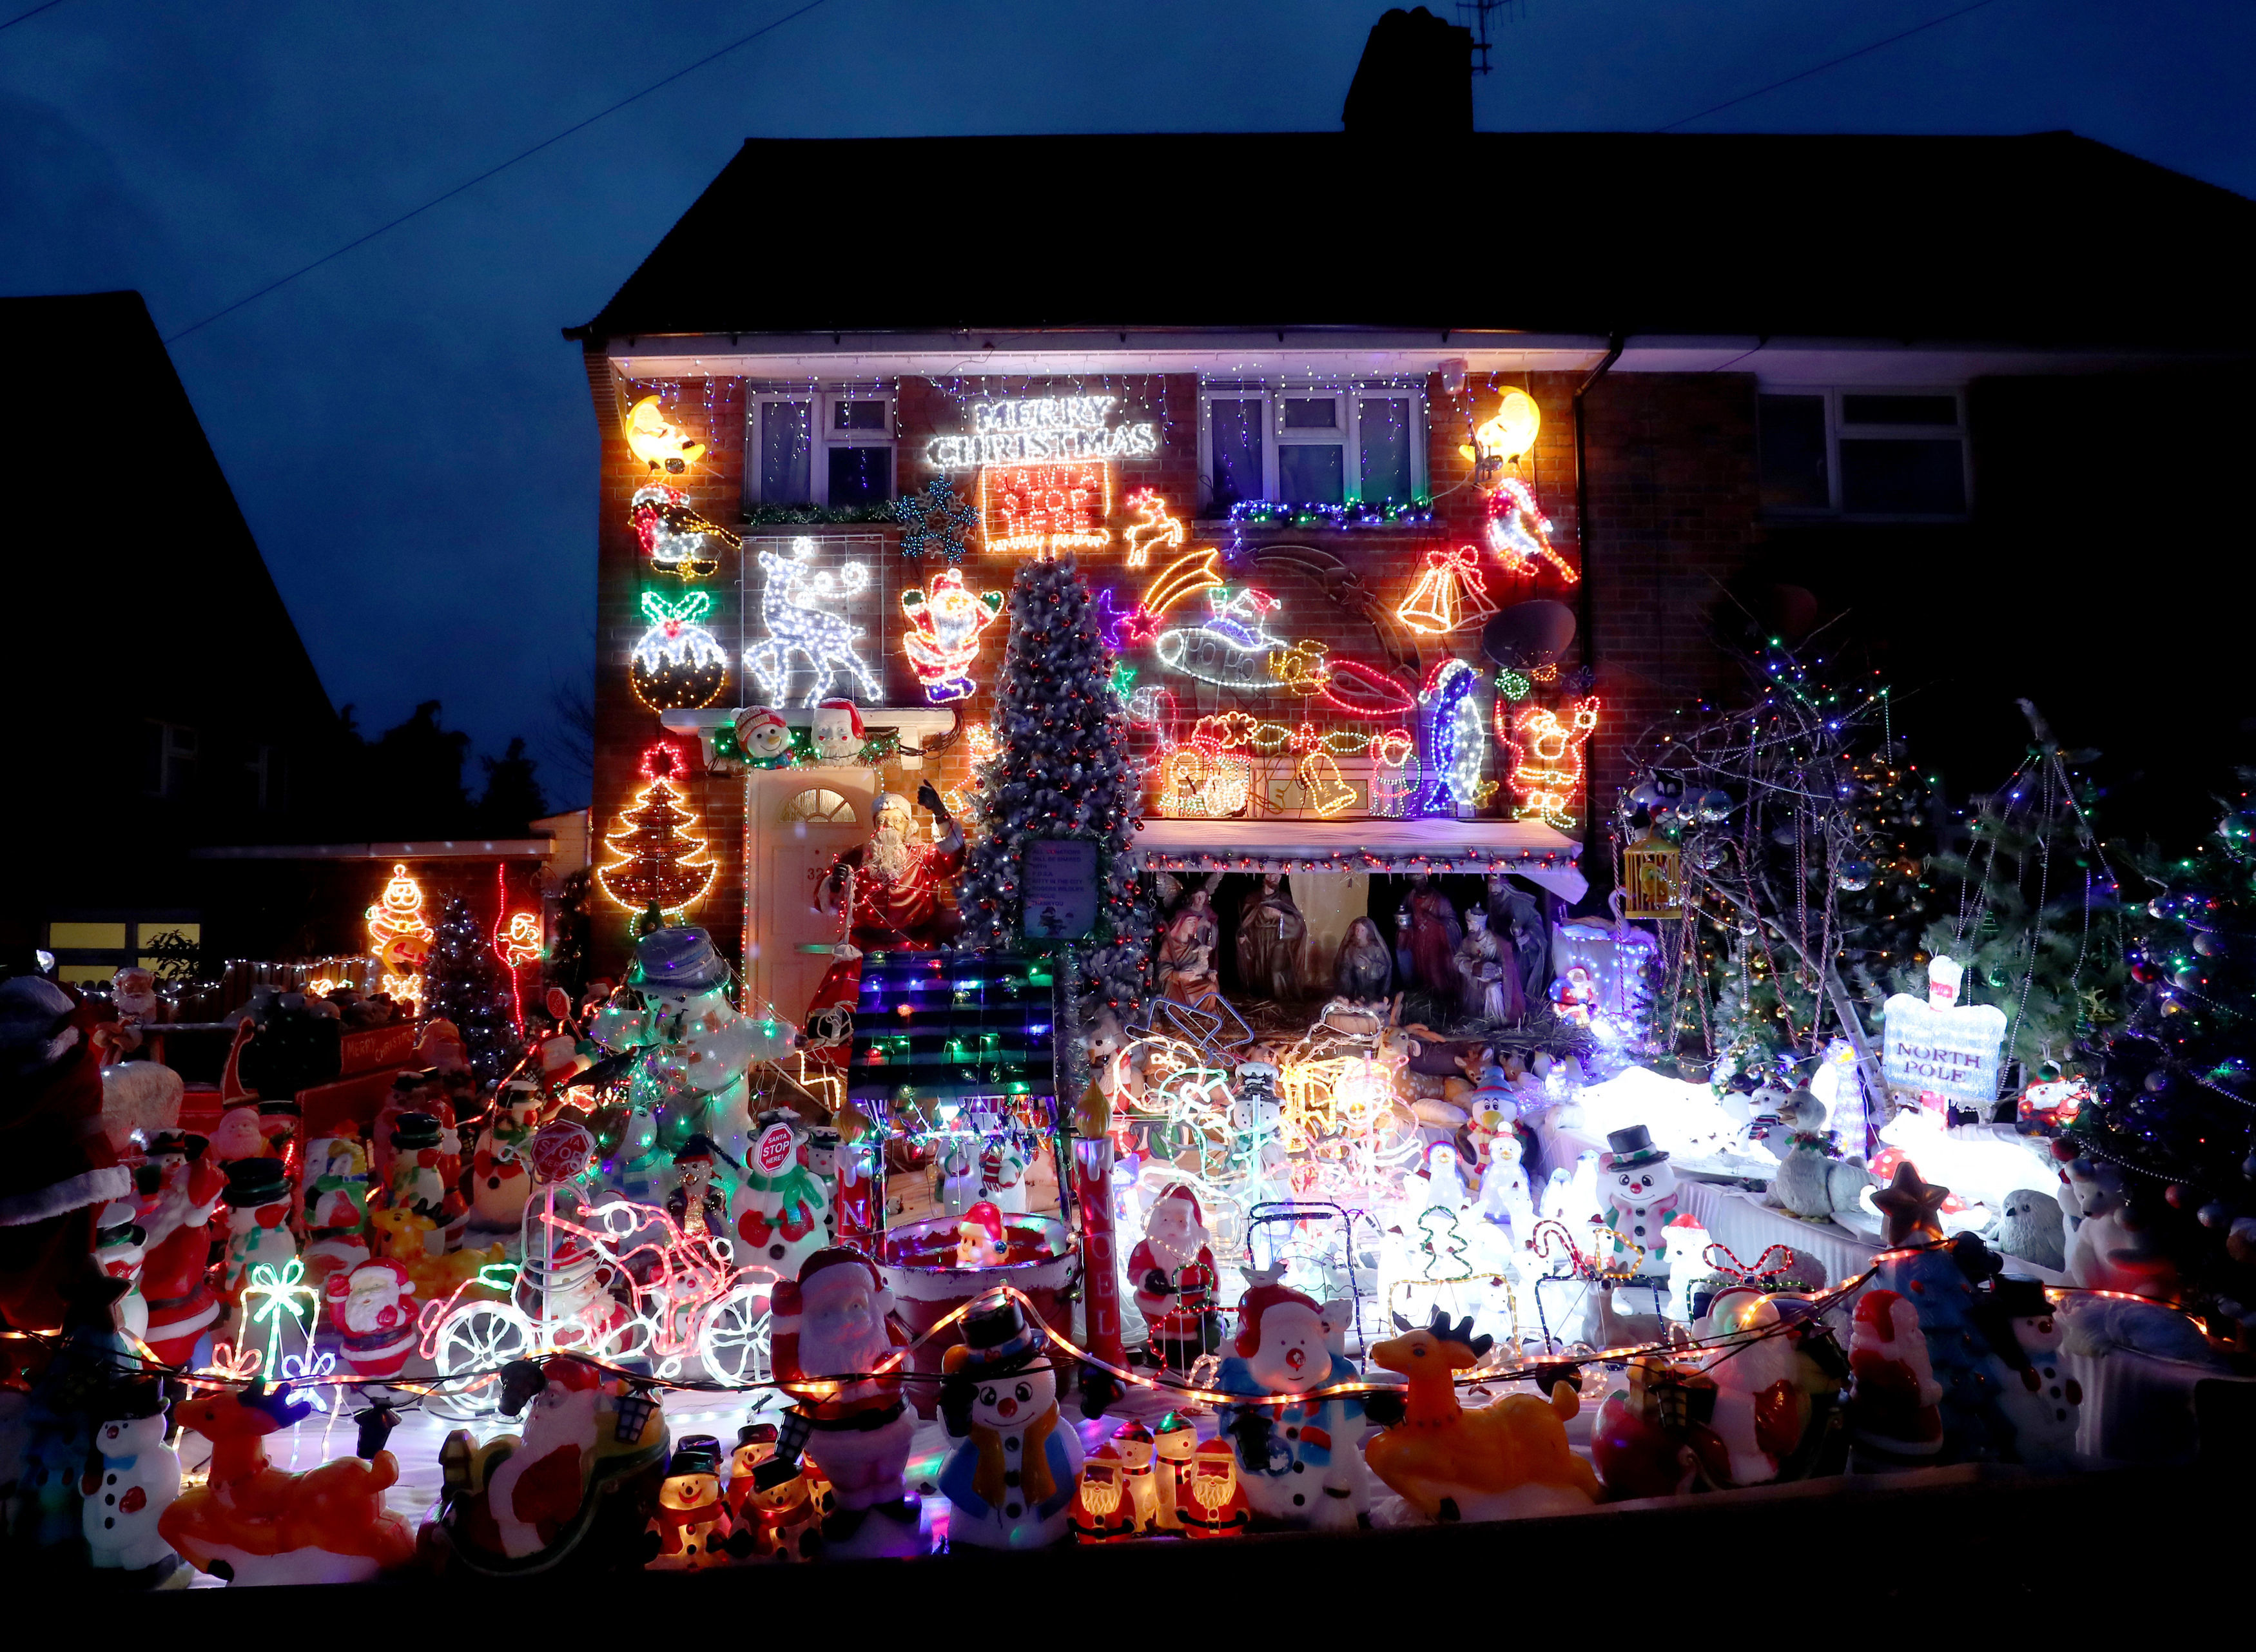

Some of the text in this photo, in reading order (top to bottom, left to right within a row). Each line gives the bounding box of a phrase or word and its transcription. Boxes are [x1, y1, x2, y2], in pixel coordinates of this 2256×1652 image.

[974, 395, 1116, 434] MERRY
[926, 423, 1157, 469] CHRISTMAS
[994, 464, 1098, 493] SANTA
[1001, 488, 1089, 516] STOP
[1007, 510, 1089, 537] HERE
[347, 1037, 376, 1058] MERRY
[1896, 1042, 1981, 1069] NORTH
[1903, 1061, 1966, 1083] POLE
[763, 1140, 790, 1158] STOP
[768, 1133, 787, 1144] SANTA
[766, 1154, 784, 1165] HERE!
[1087, 1193, 1115, 1336] NOEL
